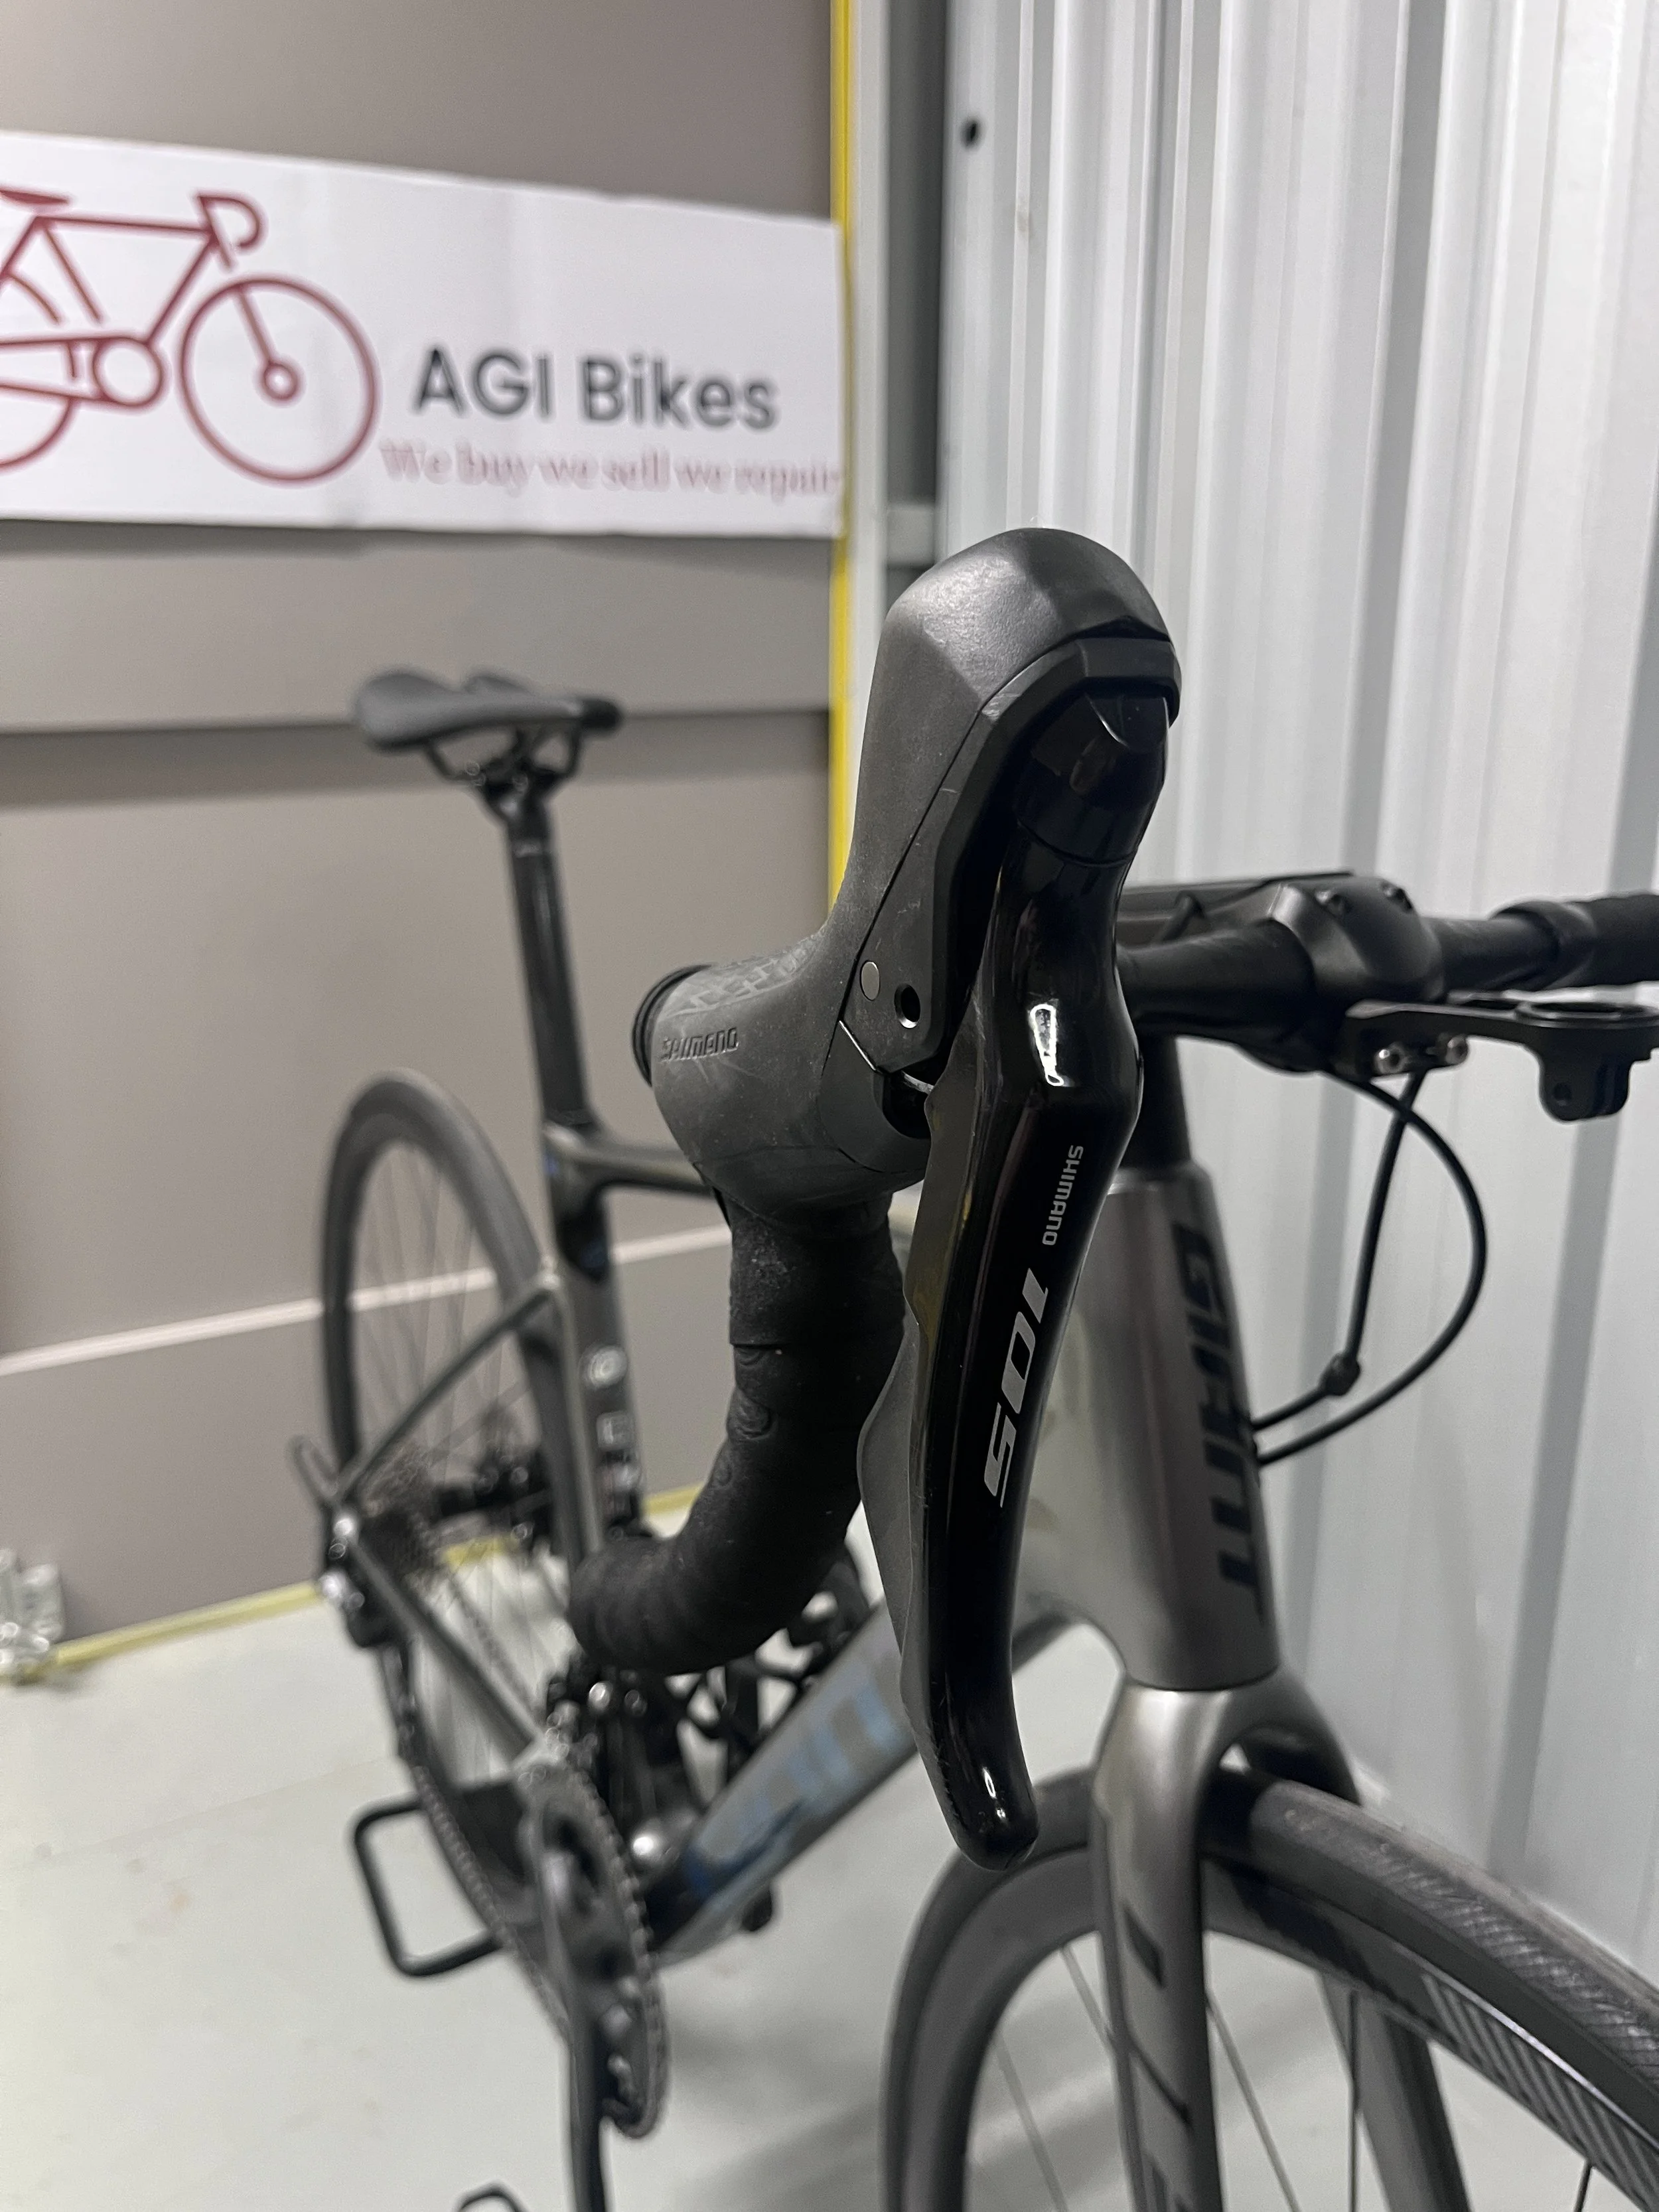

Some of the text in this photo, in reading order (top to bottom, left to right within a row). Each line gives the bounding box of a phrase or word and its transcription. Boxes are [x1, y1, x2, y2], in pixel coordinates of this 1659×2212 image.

[410, 345, 776, 430] AGI Bikes
[379, 438, 452, 484] We
[455, 435, 529, 498] buy
[660, 1026, 739, 1063] SHIMANO
[1041, 1144, 1084, 1246] SHIMANO
[983, 1267, 1049, 1509] 105
[1173, 1220, 1266, 1627] GIANT
